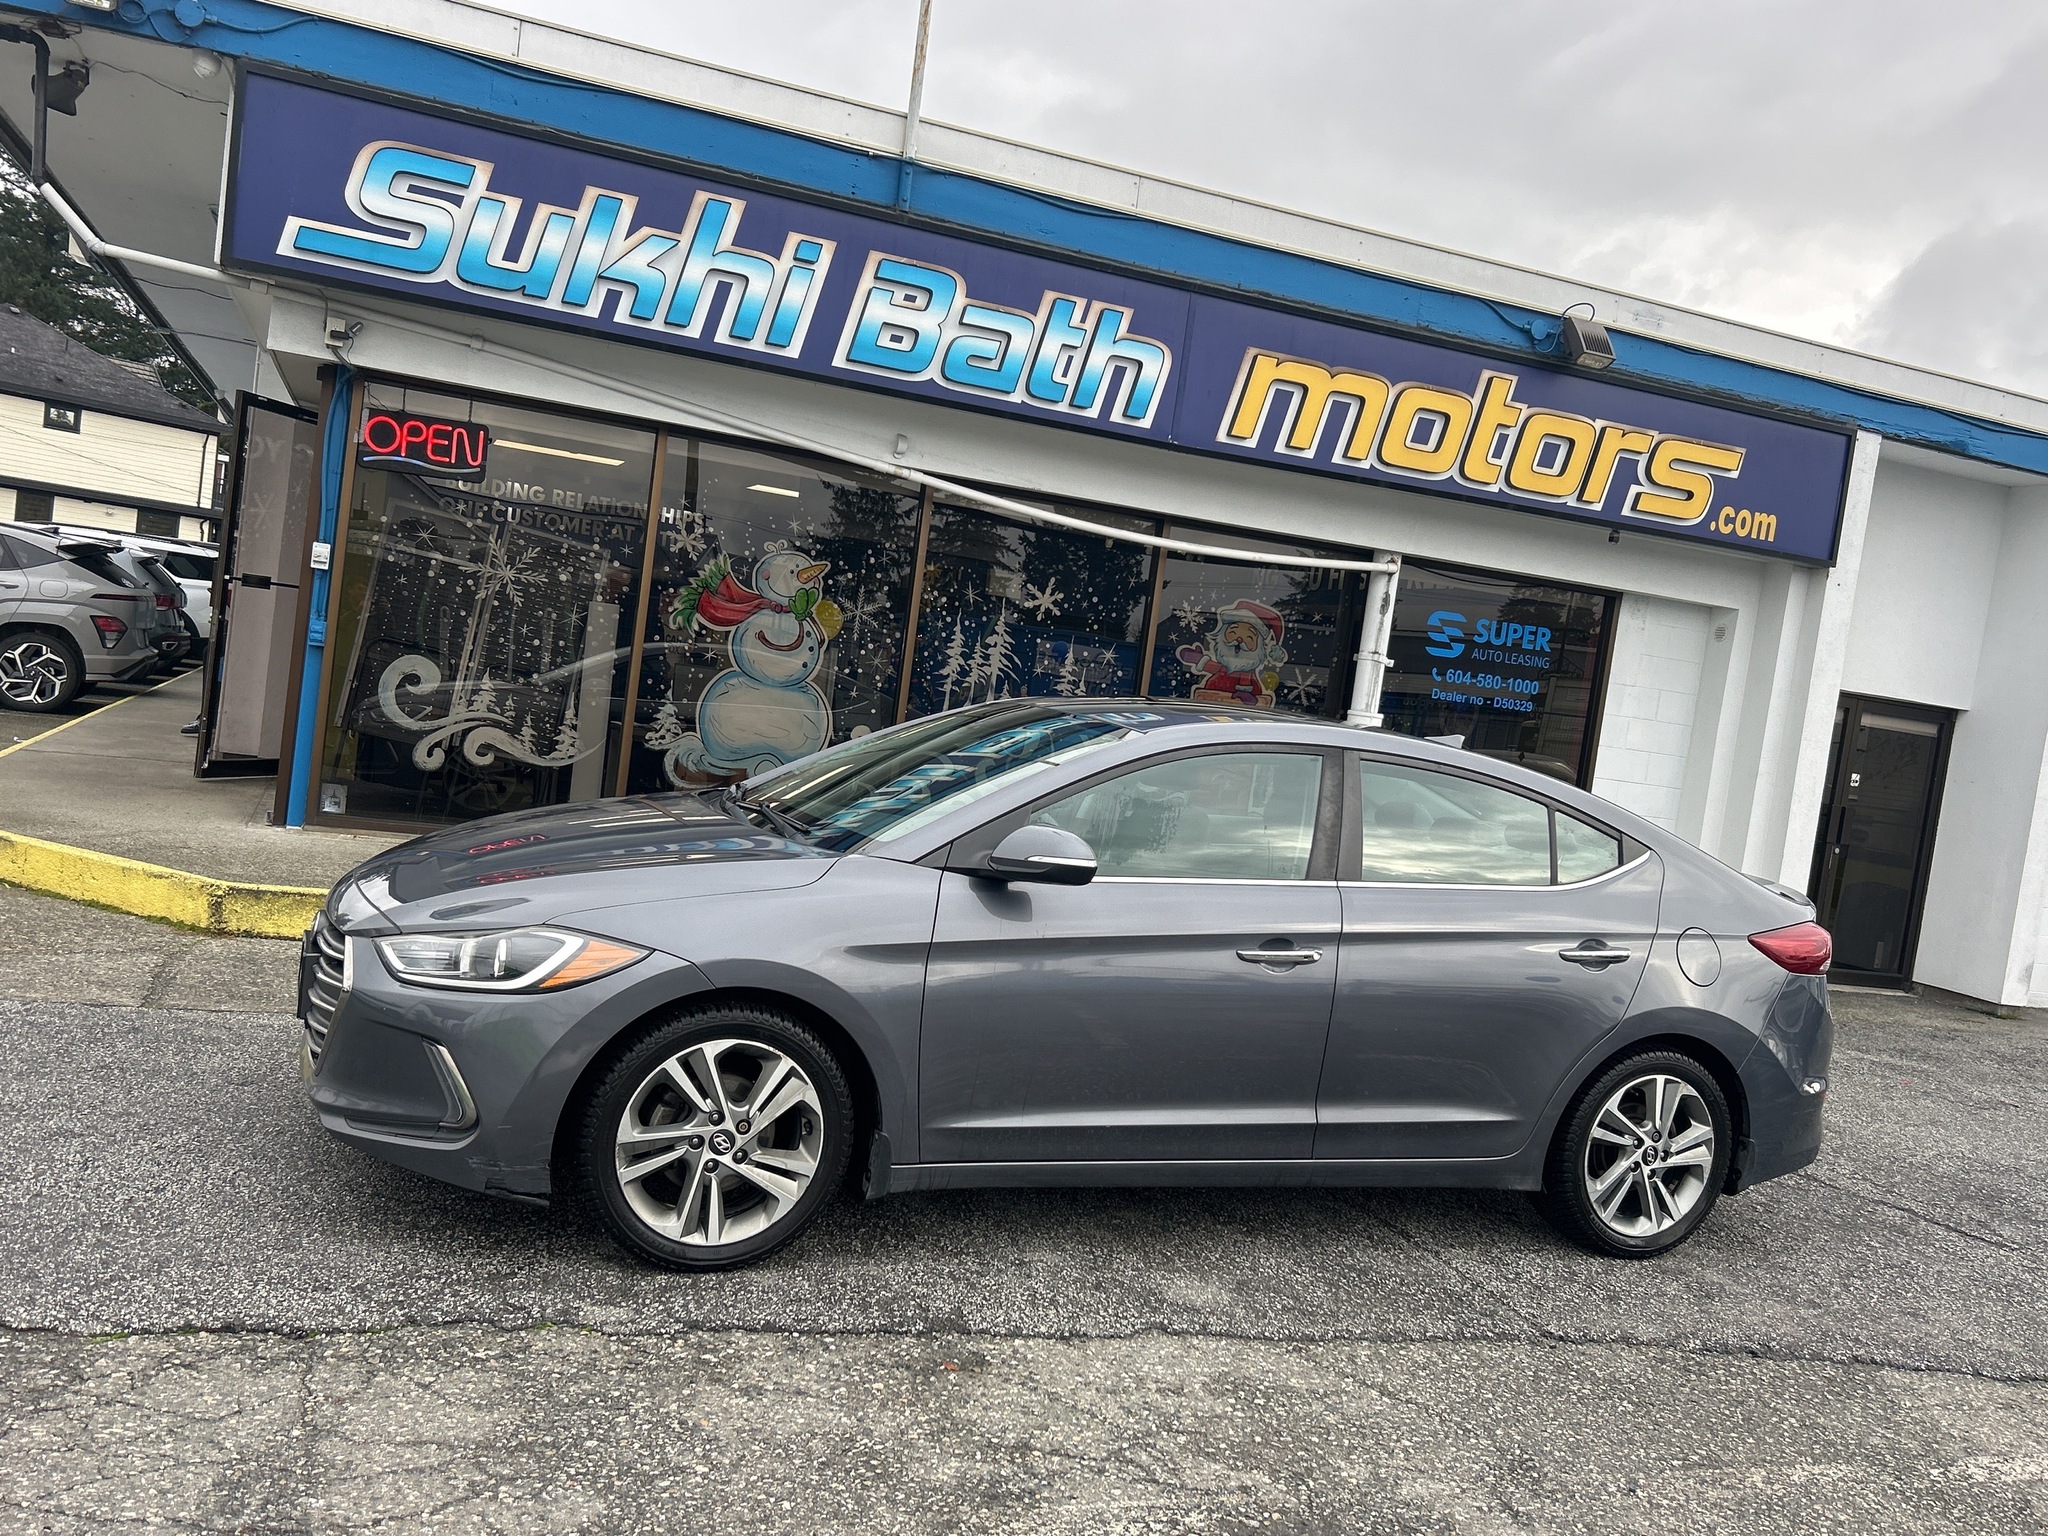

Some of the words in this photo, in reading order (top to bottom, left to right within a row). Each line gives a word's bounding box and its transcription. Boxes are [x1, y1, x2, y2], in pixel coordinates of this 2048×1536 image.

[281, 143, 831, 356] Sukhi
[838, 254, 1168, 425] Bath
[1219, 350, 1742, 522] motors
[363, 414, 485, 467] OPEN
[491, 504, 605, 538] CUSTOMER
[609, 523, 636, 542] AT
[1473, 617, 1552, 652] SUPER
[1471, 648, 1503, 663] AUTO
[1504, 652, 1551, 669] LEASING
[1445, 668, 1539, 695] 604-580-1000
[1431, 688, 1467, 704] Dealer
[1469, 696, 1484, 706] no
[1493, 697, 1533, 713] D50329
